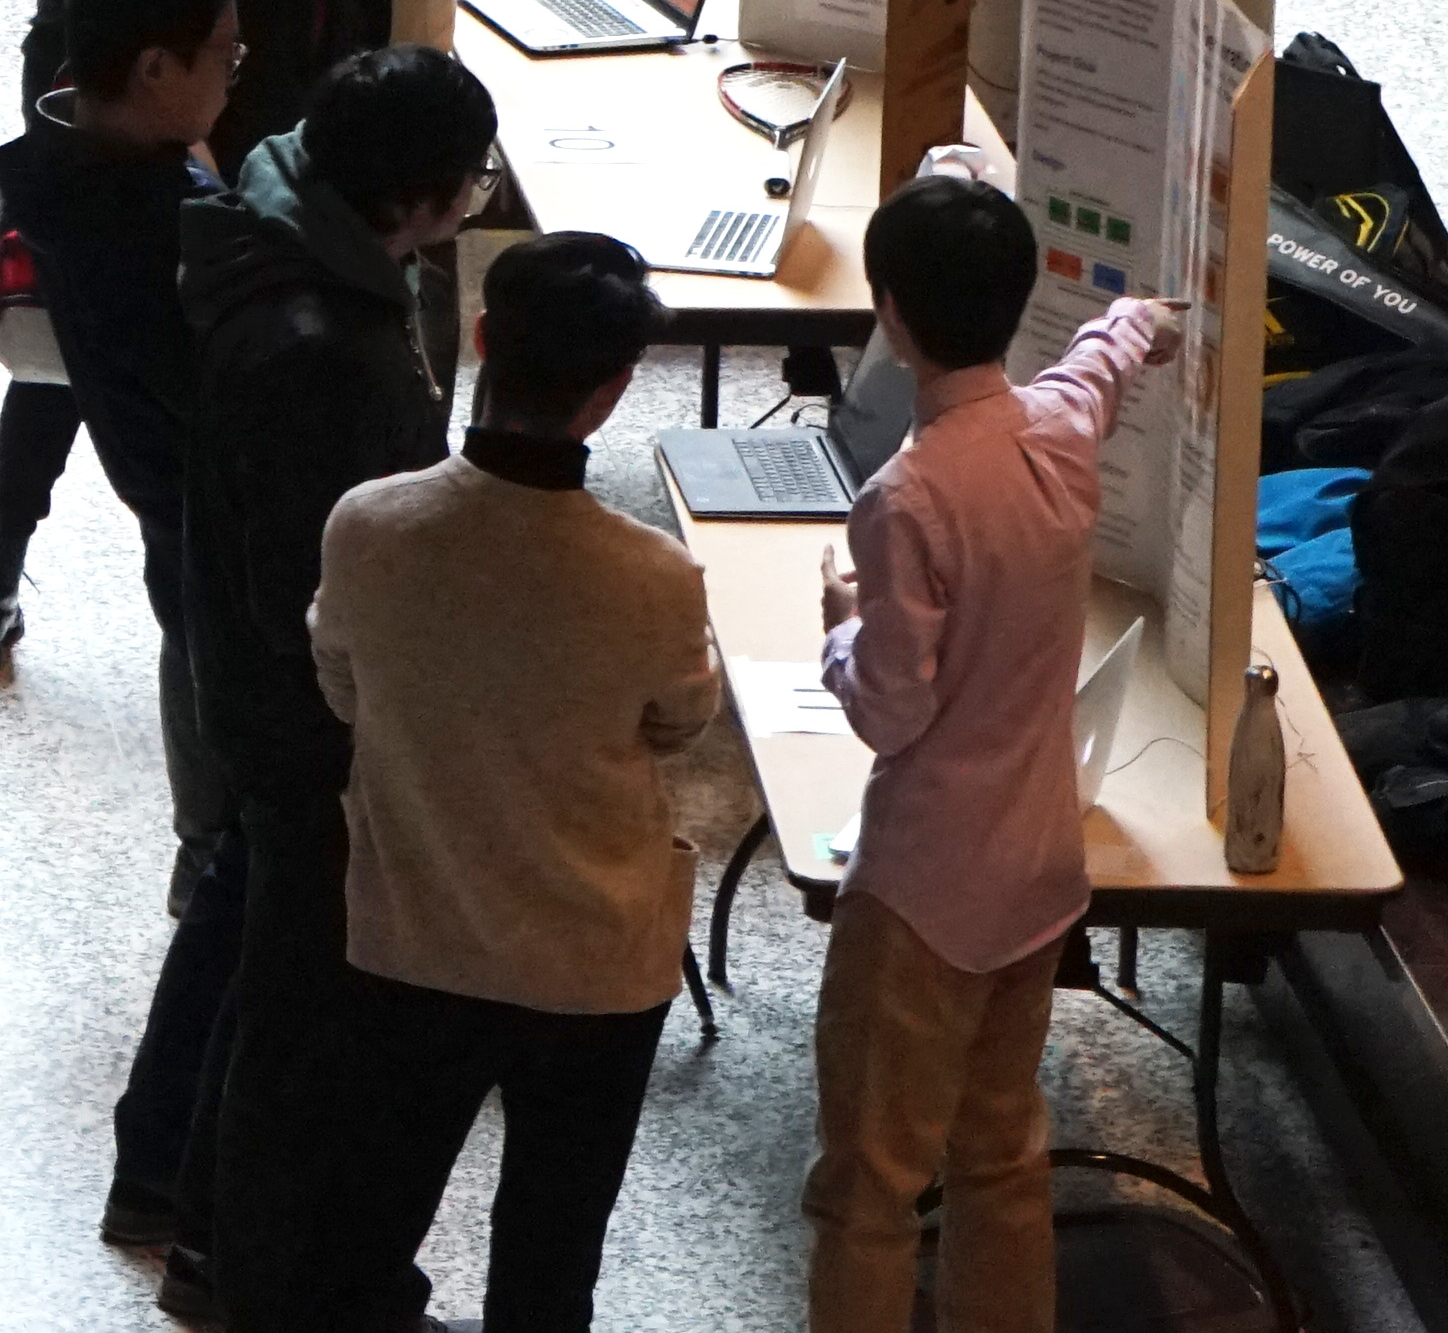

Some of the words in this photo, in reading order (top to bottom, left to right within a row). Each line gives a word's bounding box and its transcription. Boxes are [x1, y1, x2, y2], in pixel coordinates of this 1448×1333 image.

[1266, 232, 1340, 275] POWER
[1339, 268, 1372, 290] OF
[1374, 284, 1419, 315] YOU
